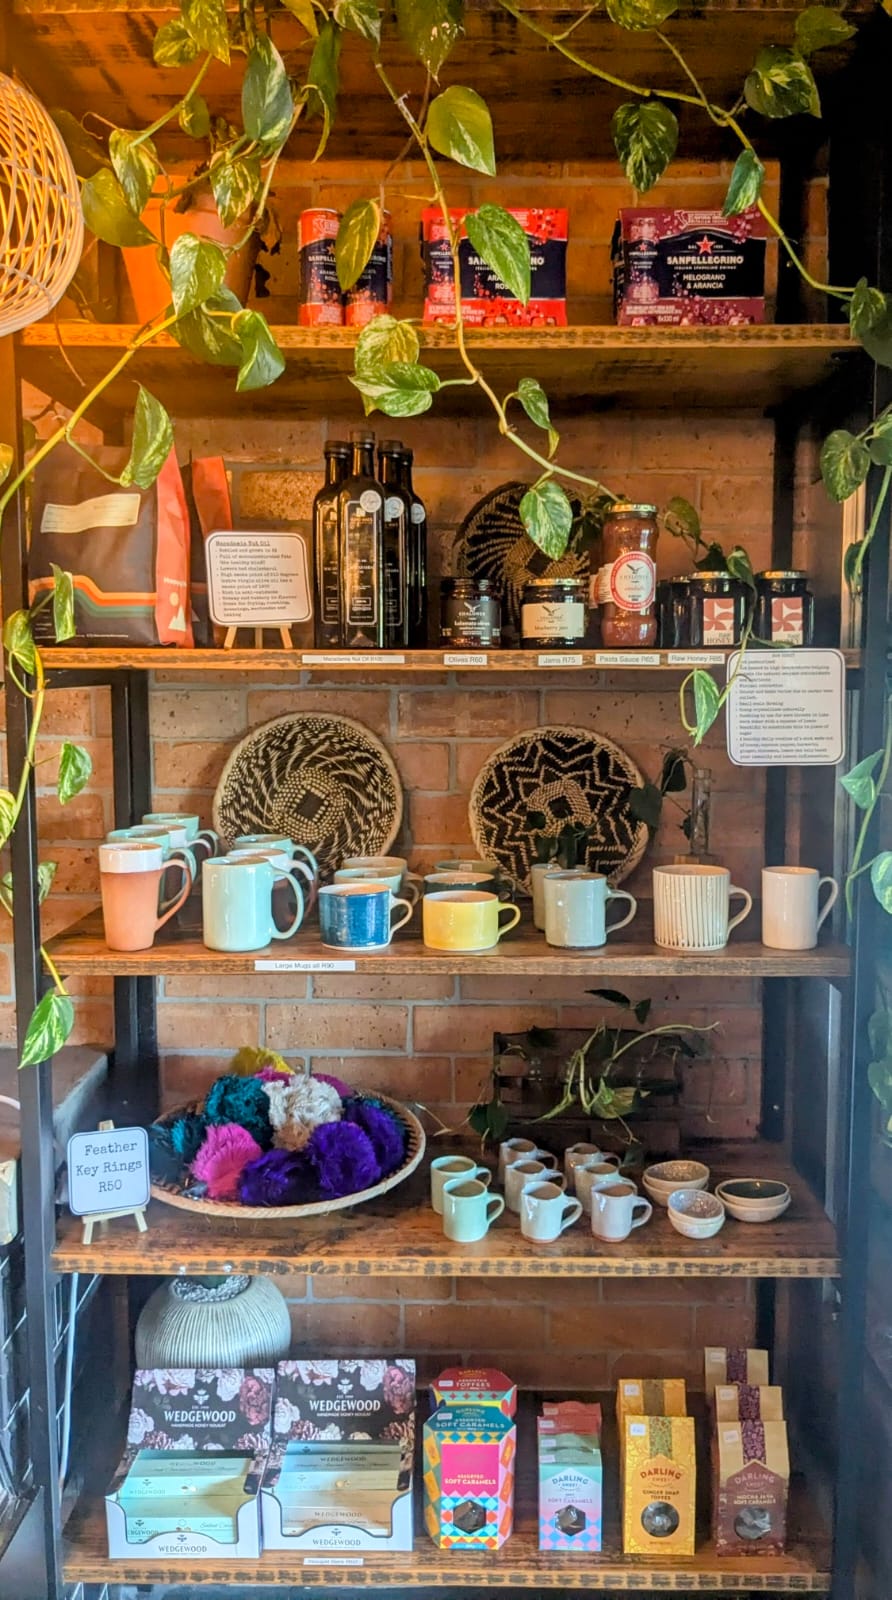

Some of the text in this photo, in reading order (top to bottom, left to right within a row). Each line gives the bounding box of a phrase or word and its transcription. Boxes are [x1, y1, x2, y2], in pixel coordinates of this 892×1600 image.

[667, 256, 744, 265] SANPELLEGRINO
[687, 655, 707, 663] Honey
[85, 1142, 138, 1156] Feather
[76, 1160, 142, 1177] Key Rings
[98, 1180, 122, 1192] R50
[309, 1399, 381, 1412] WEDGEWOOD
[164, 1410, 236, 1423] WEDGEWOOD
[552, 1475, 589, 1485] DARLING
[640, 1468, 682, 1480] DARLING
[734, 1472, 775, 1484] DARLING
[312, 1538, 361, 1546] WEDGEWOOD
[158, 1545, 208, 1553] WEDGEWOOD
